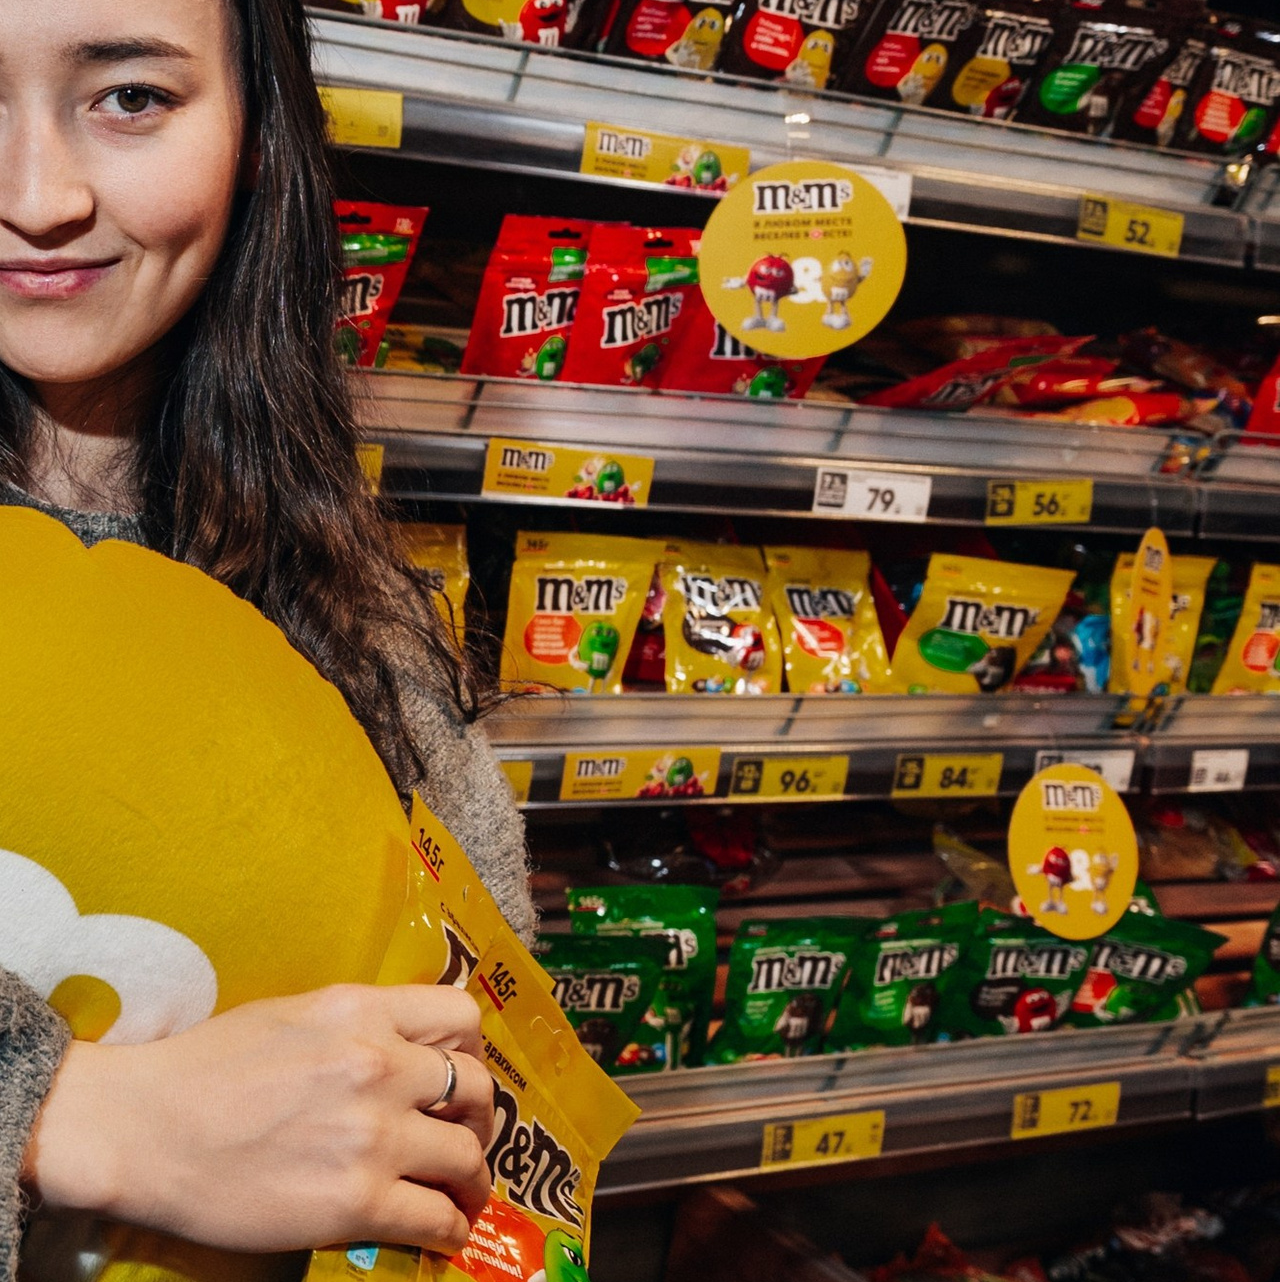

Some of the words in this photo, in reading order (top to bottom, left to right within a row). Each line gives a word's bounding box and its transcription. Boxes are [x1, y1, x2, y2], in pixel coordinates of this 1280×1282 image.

[1123, 219, 1150, 246] 52
[866, 487, 895, 514] 79
[1033, 492, 1060, 517] 56
[780, 769, 810, 793] 96
[939, 765, 969, 788] 84
[419, 827, 446, 874] 145г
[487, 961, 519, 1004] 145г
[483, 1039, 528, 1093] арахисом
[1069, 1100, 1094, 1122] 72
[815, 1131, 846, 1155] 47
